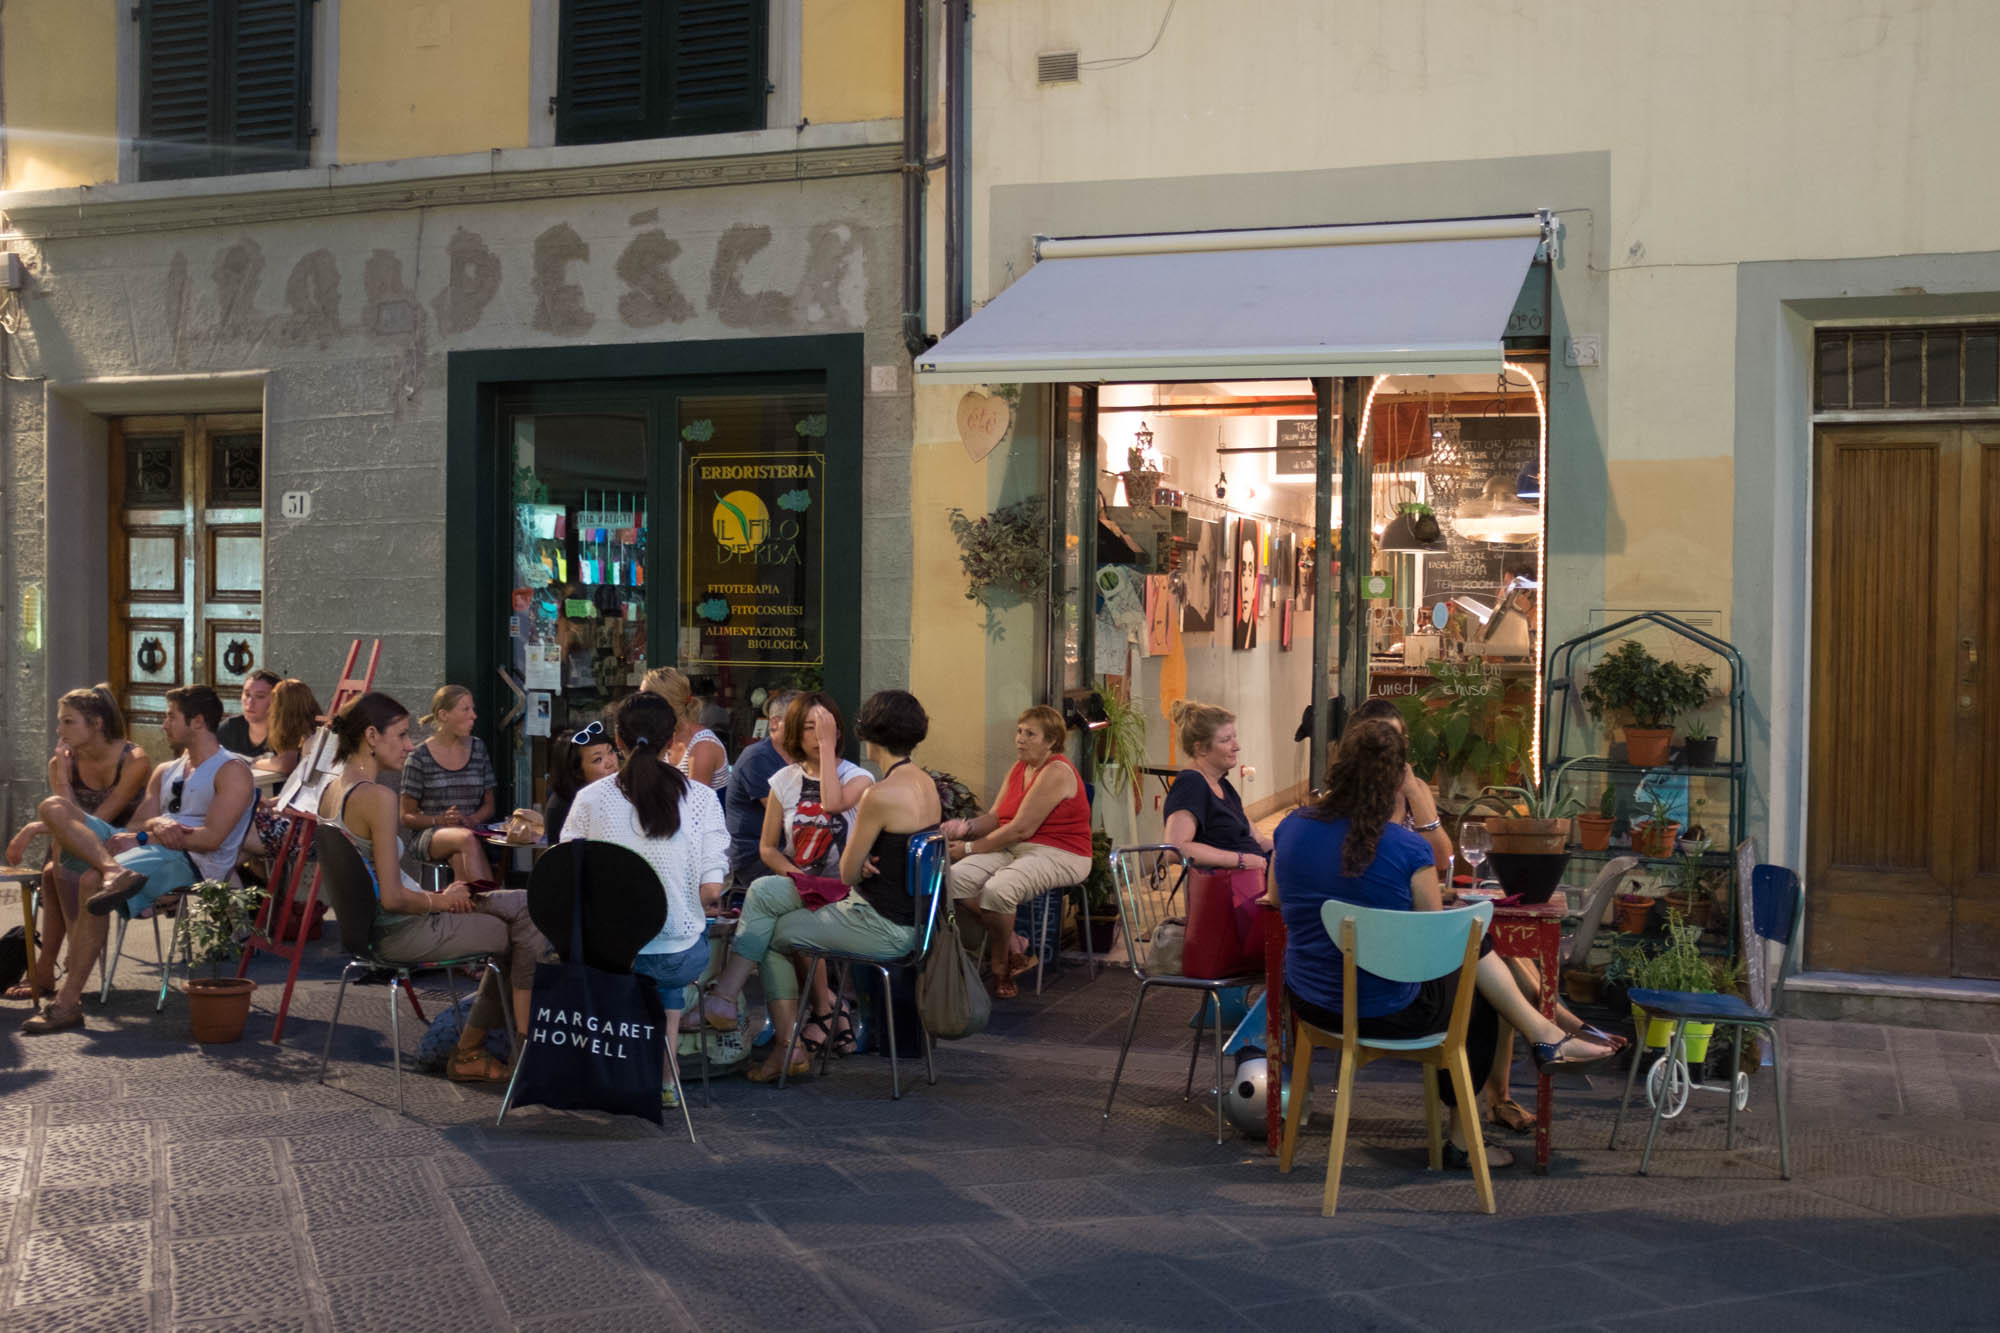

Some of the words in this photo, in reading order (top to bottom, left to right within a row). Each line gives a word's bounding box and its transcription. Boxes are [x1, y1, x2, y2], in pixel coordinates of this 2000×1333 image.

[701, 464, 816, 480] ERBORISTERIA
[288, 495, 304, 515] 51
[716, 519, 736, 541] IL
[708, 584, 781, 594] FITOTERAPIA
[731, 605, 804, 616] FITOCOSMESI
[705, 626, 798, 637] ALIMENTAZIONE
[748, 639, 809, 650] BIOLOGICA
[536, 1007, 655, 1041] MARGARET
[533, 1028, 627, 1059] HOWELL
